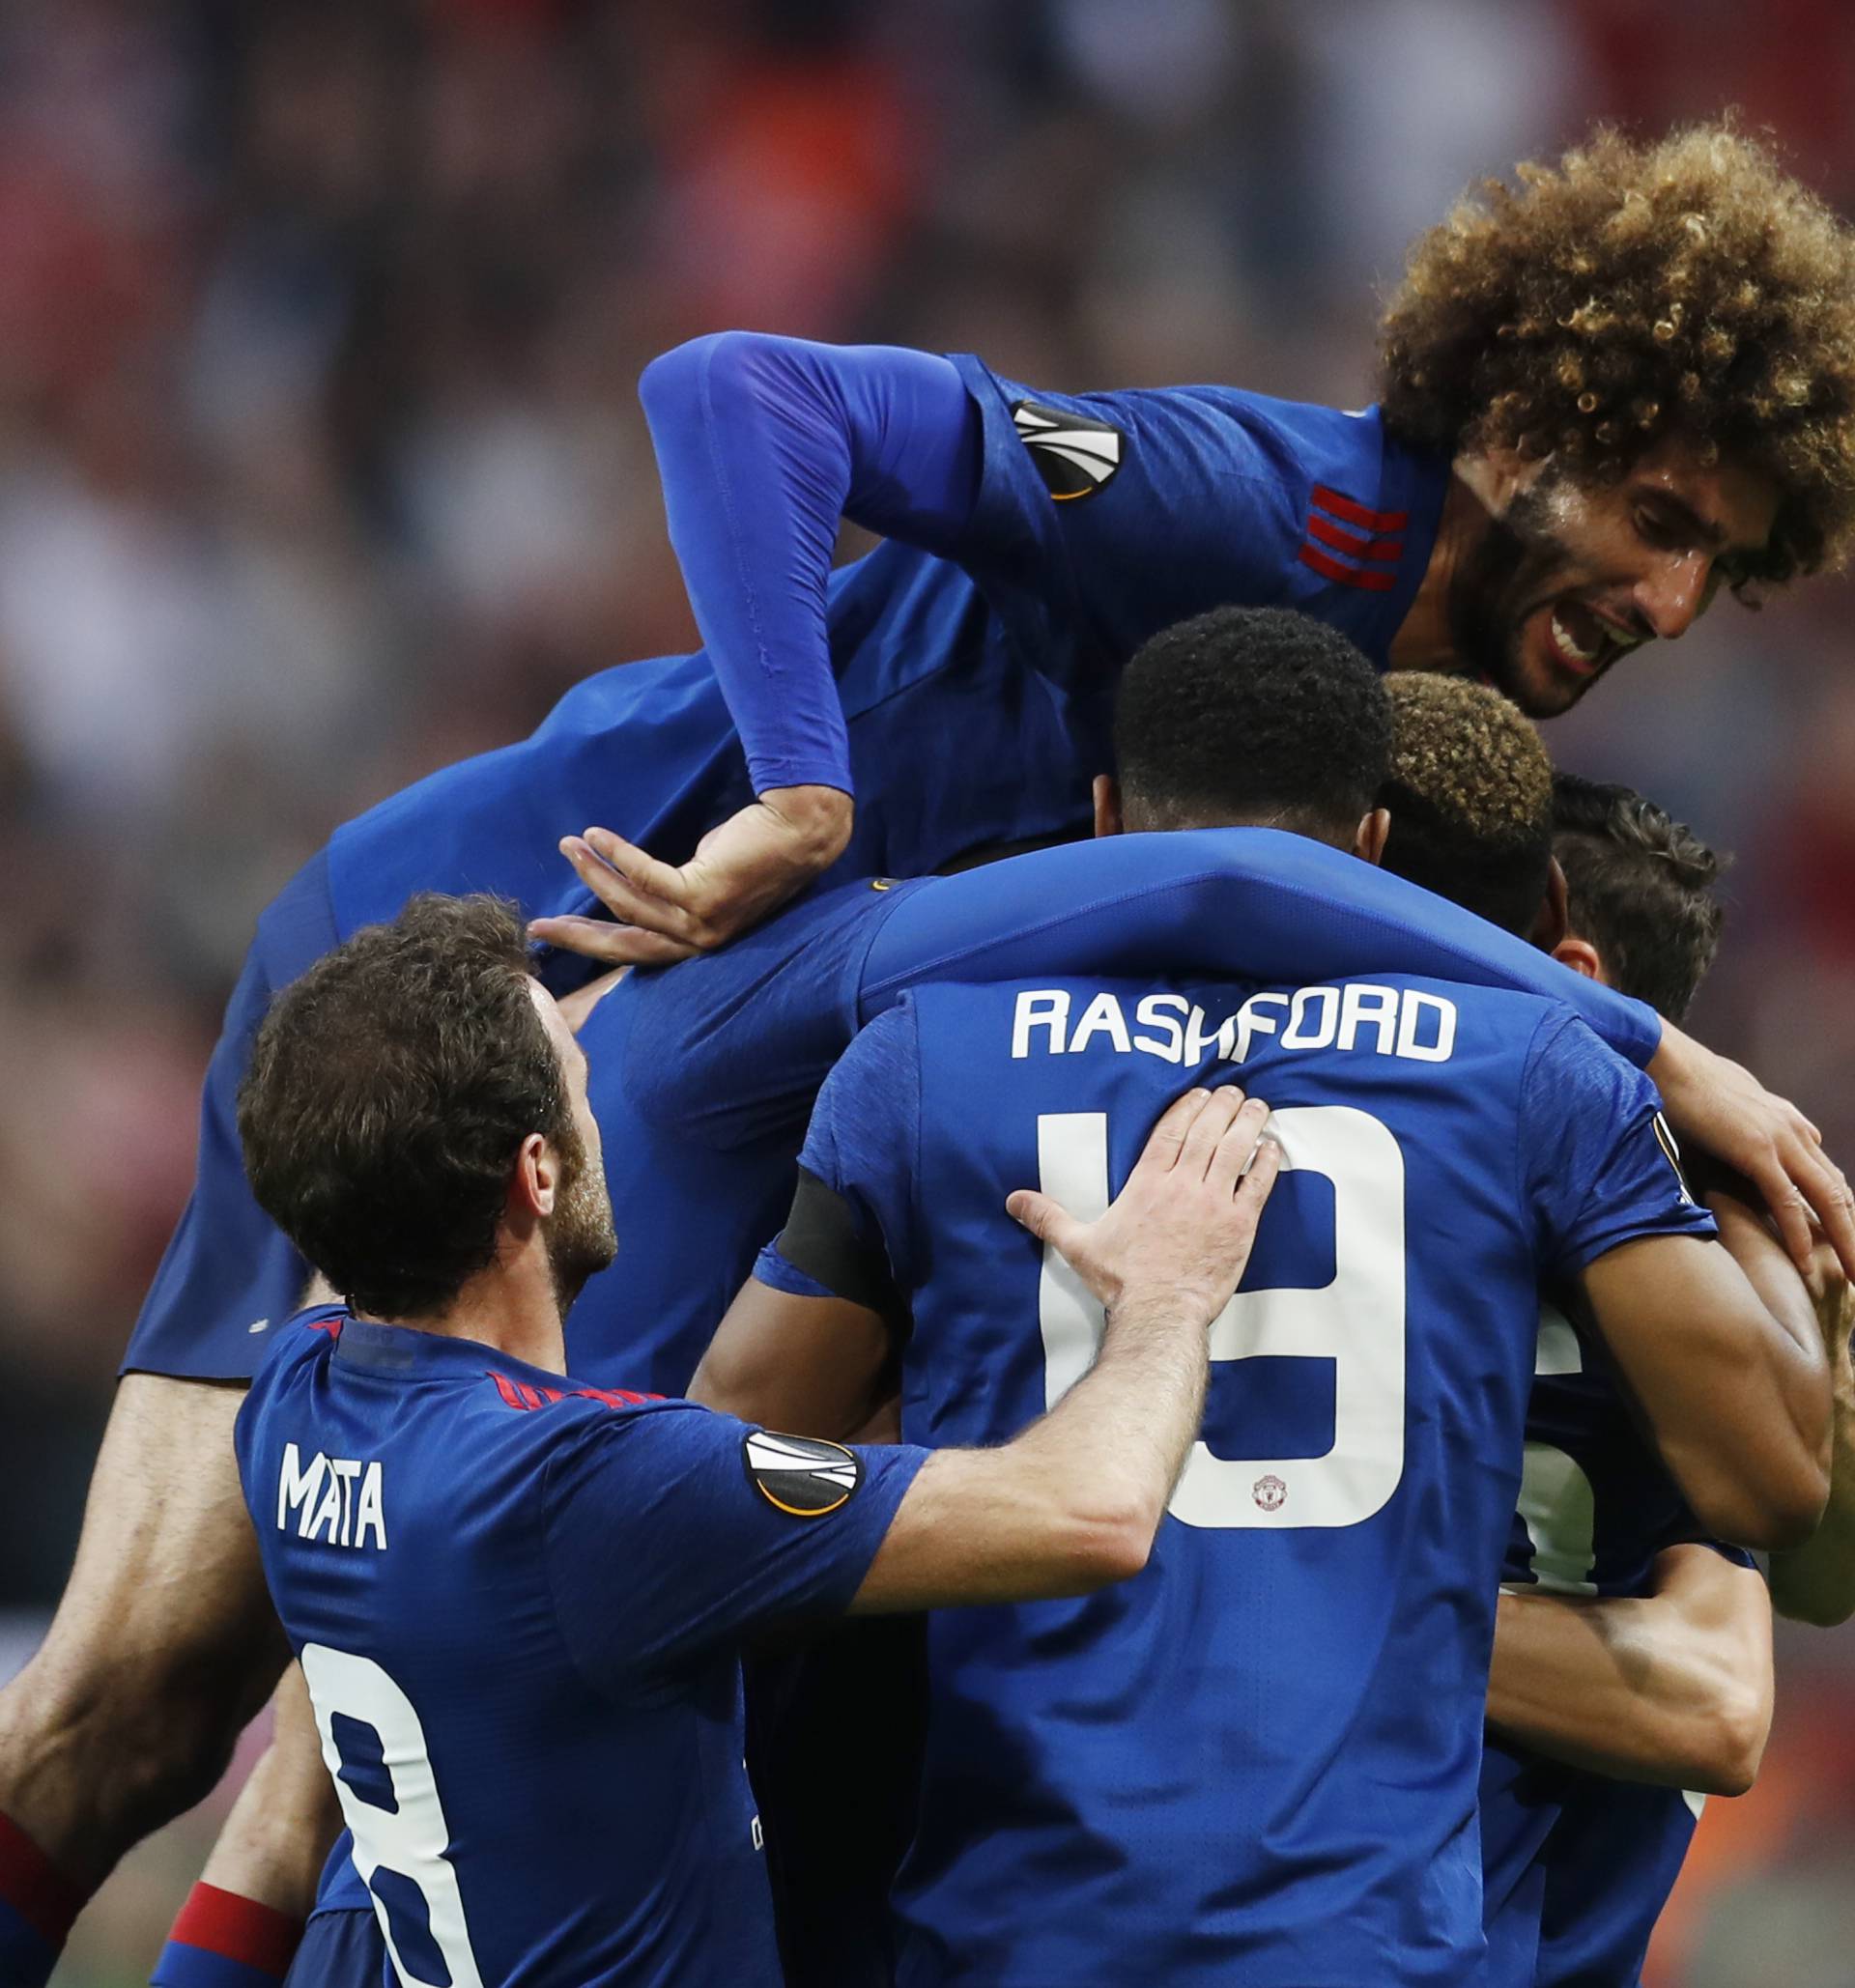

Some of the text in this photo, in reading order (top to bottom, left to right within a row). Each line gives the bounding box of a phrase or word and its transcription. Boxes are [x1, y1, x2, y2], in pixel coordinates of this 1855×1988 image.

[1012, 983, 1458, 1067] RASHFORD
[1037, 1105, 1406, 1529] 19
[277, 1442, 387, 1550] MATA
[300, 1642, 484, 1988] 8
